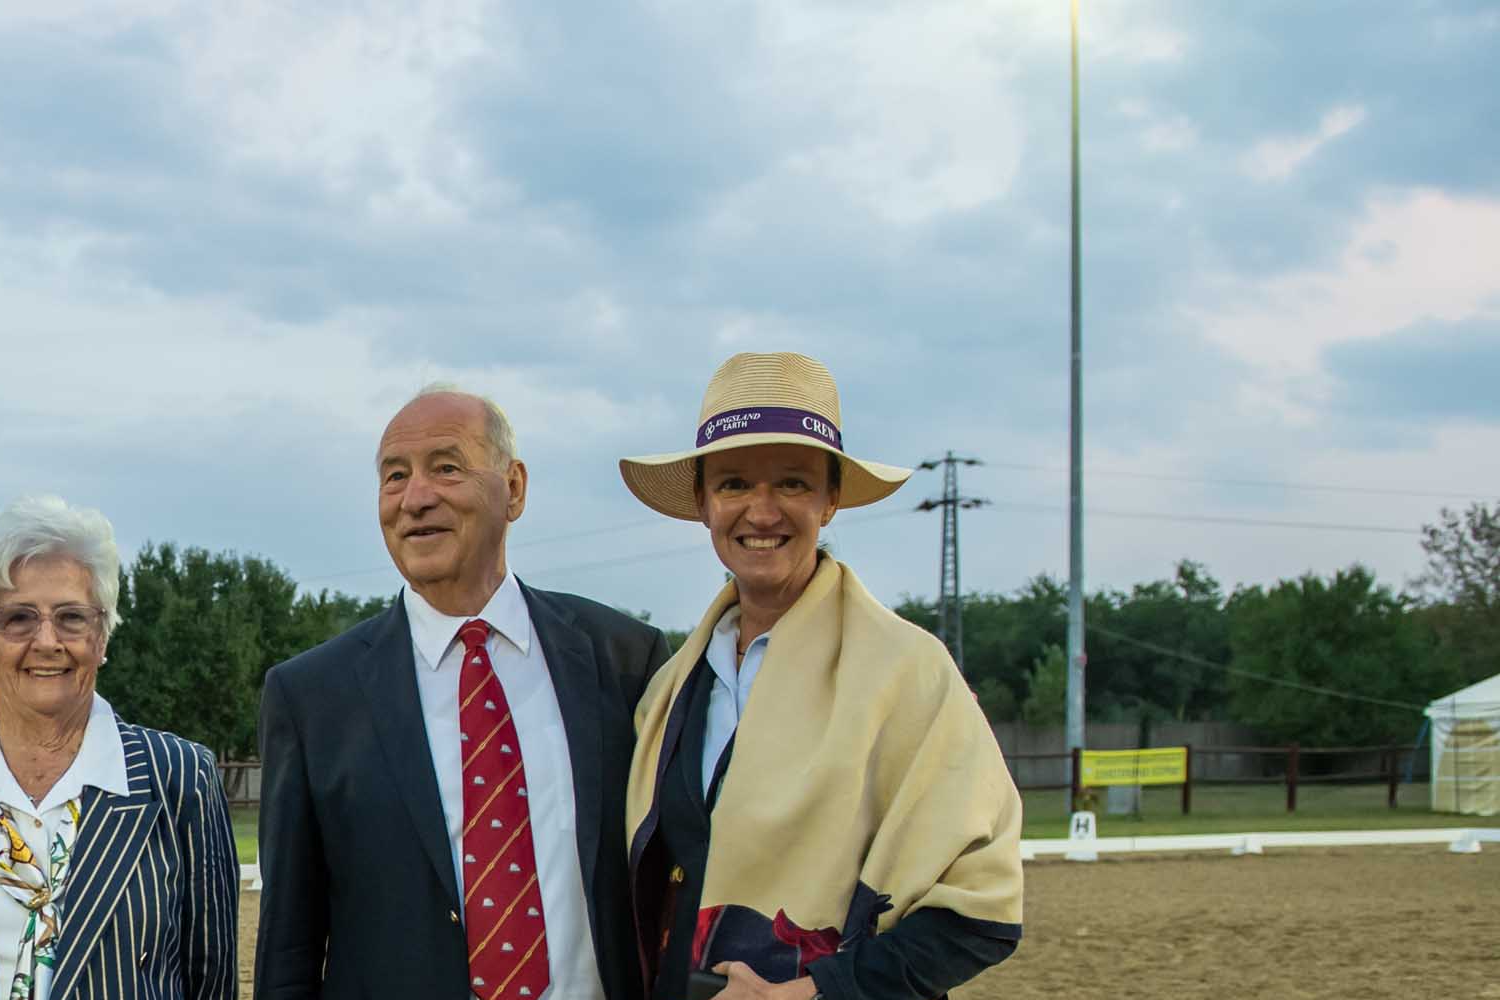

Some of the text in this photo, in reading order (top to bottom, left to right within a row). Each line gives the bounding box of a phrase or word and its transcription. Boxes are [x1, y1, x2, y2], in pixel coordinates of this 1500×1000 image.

[715, 412, 761, 428] KINGSLAND
[722, 420, 748, 432] EARTH
[802, 416, 835, 442] CREW
[1076, 817, 1090, 833] H
